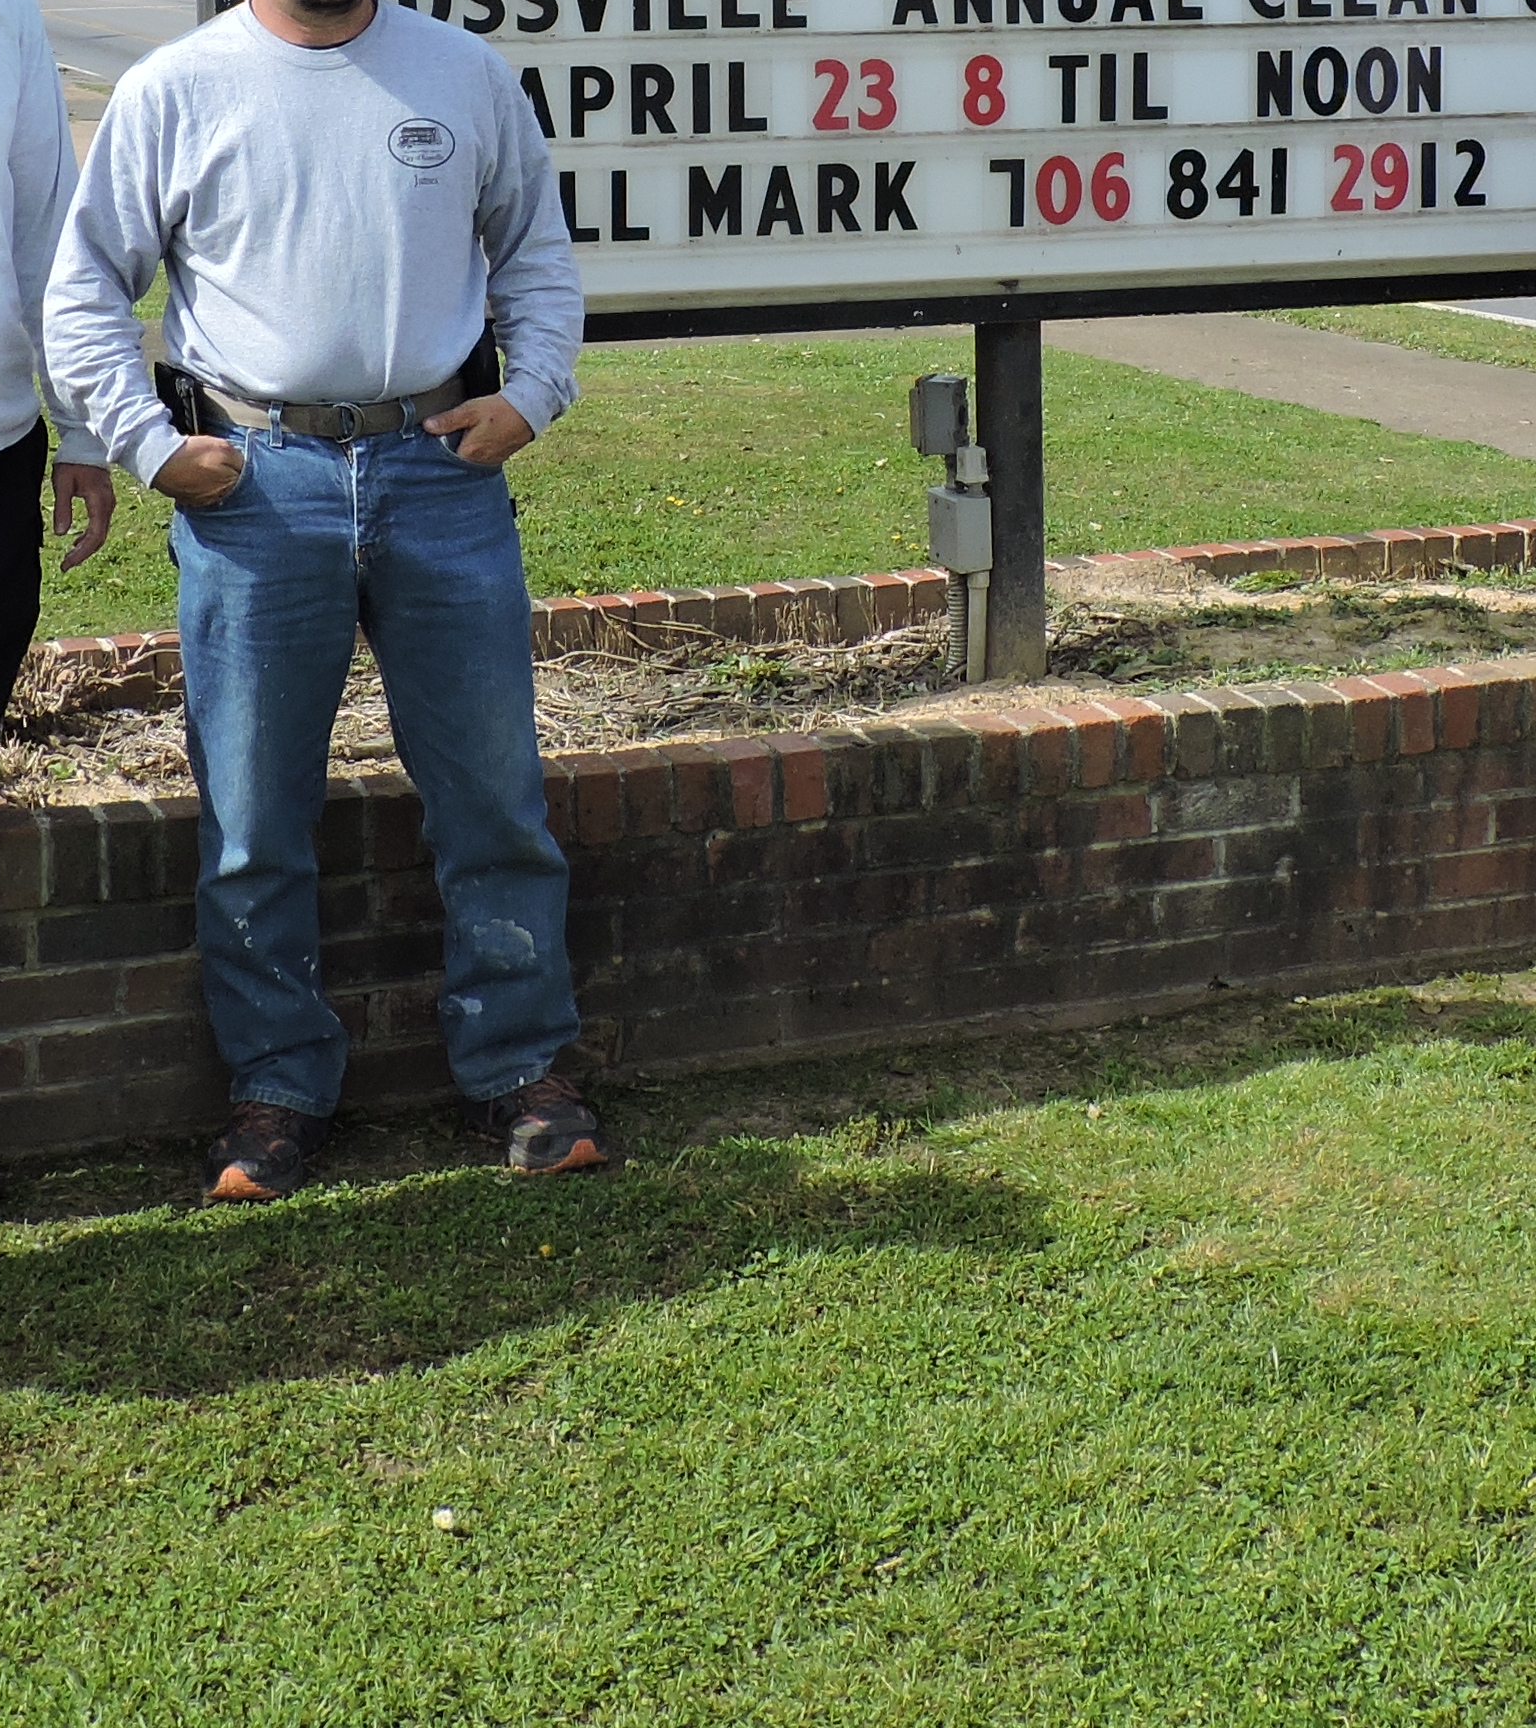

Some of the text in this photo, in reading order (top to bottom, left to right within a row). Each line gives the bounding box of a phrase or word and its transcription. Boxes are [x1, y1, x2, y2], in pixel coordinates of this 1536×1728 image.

[519, 46, 1443, 140] APRIL 23 8 TIL NOON
[558, 139, 1488, 244] LL MARK 706 841 2912
